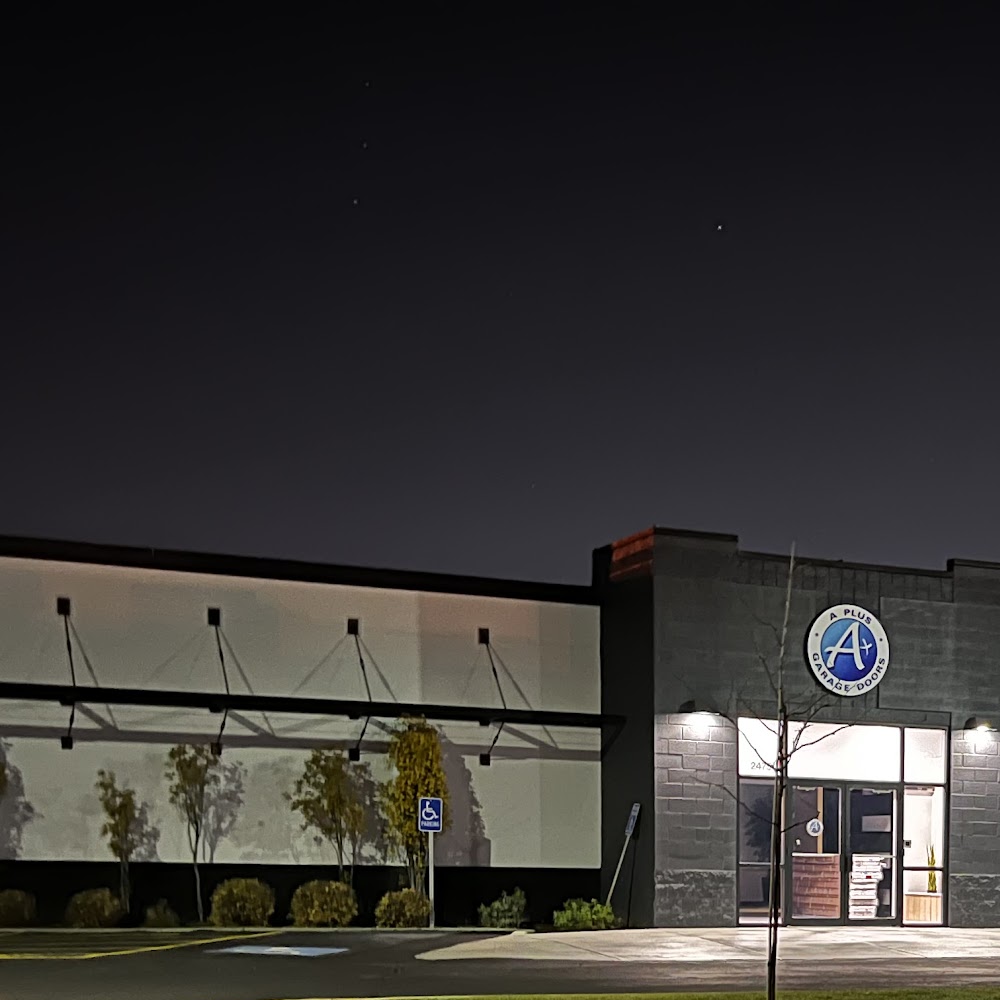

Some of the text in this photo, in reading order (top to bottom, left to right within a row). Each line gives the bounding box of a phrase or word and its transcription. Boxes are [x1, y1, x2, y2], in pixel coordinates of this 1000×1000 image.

[829, 608, 872, 624] A PLUS
[812, 652, 886, 691] GARAGE DOORS
